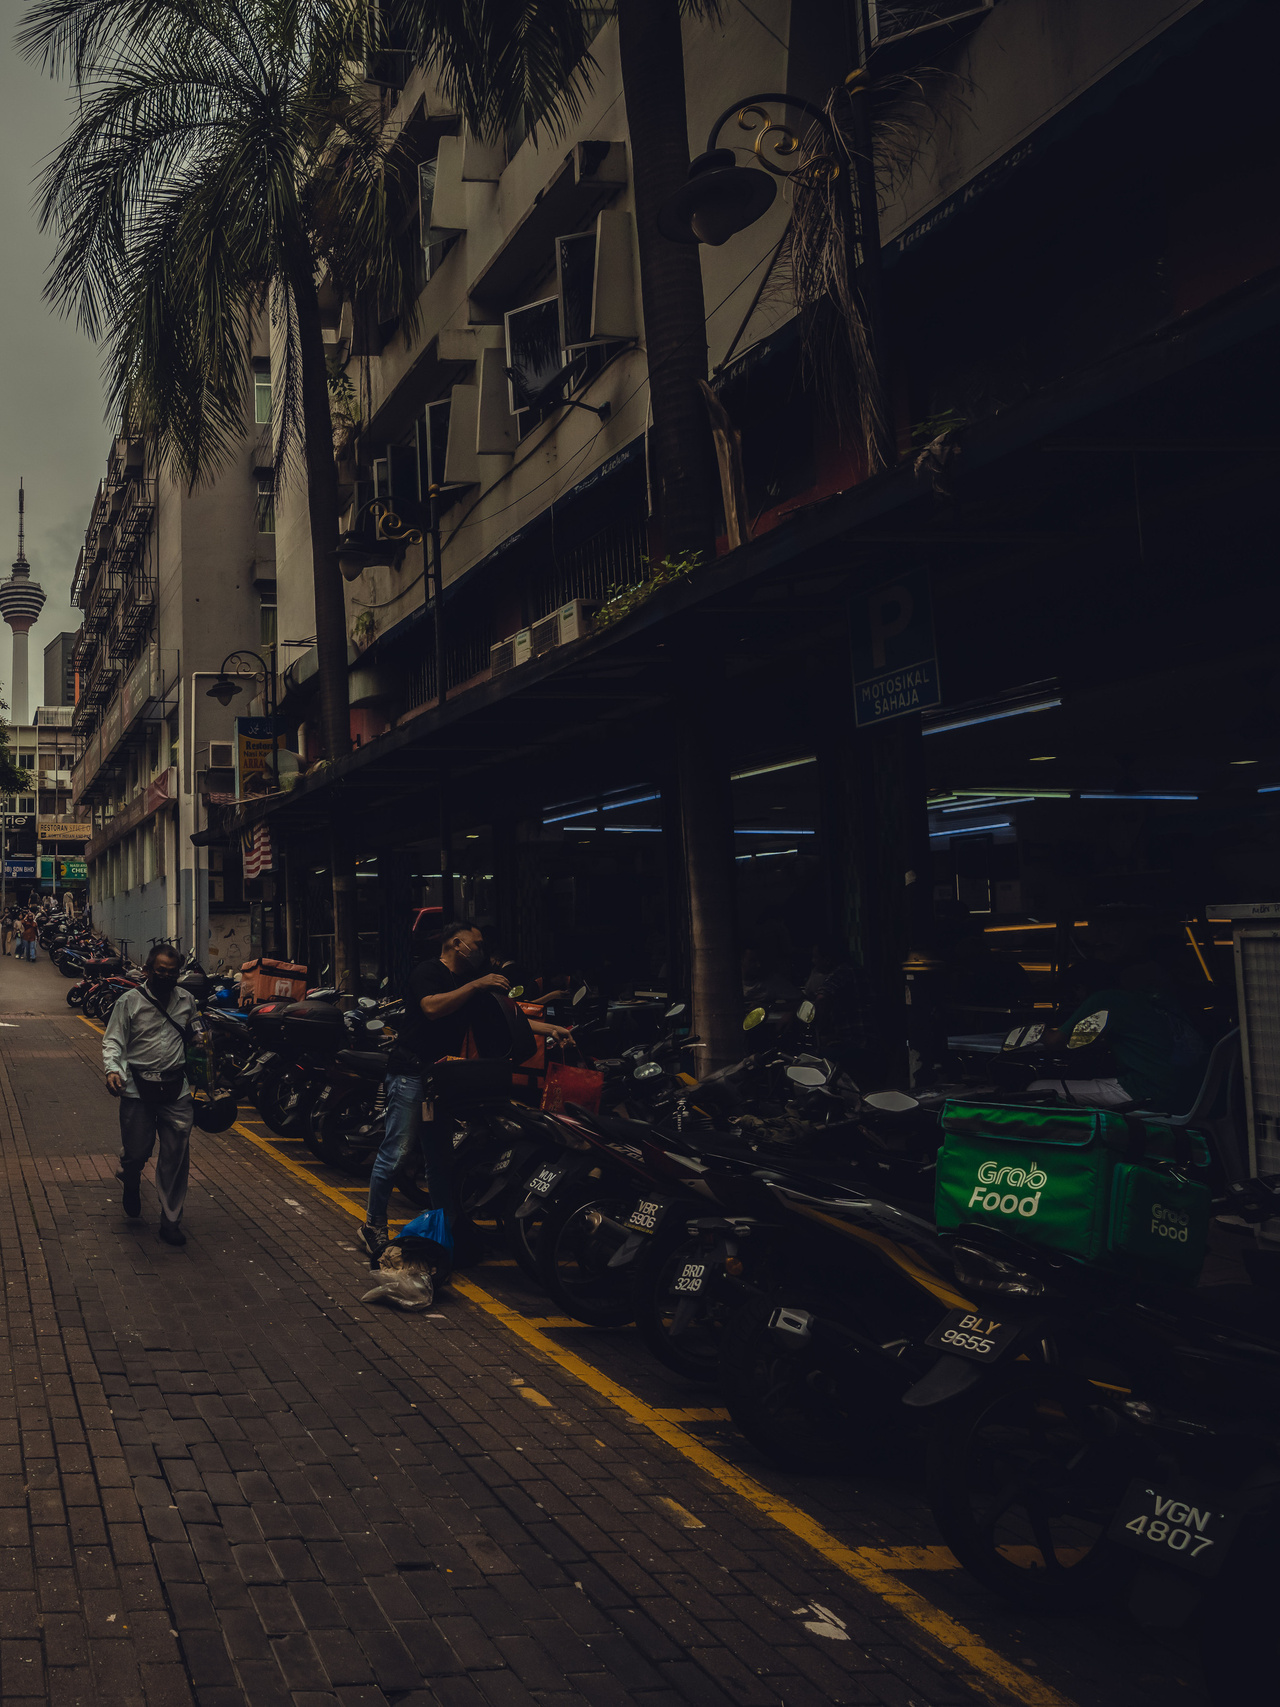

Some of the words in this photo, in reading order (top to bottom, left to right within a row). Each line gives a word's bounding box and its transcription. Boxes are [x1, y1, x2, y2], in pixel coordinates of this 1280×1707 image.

[868, 585, 914, 669] P
[861, 668, 930, 702] MOTOSIKAL
[874, 688, 920, 715] SAHAJA
[529, 1177, 550, 1193] 5708
[538, 1169, 557, 1182] WUV
[977, 1161, 1048, 1189] Grab
[638, 1200, 659, 1216] VBR
[968, 1186, 1042, 1217] Food
[629, 1211, 657, 1228] 5906
[1151, 1203, 1190, 1226] Grab
[1151, 1219, 1188, 1242] Food
[681, 1264, 705, 1278] BRD
[674, 1277, 702, 1292] 3249
[958, 1314, 1002, 1336] BLY
[940, 1329, 996, 1354] 9655
[1154, 1495, 1212, 1532] VGN
[1125, 1515, 1214, 1558] 4807
